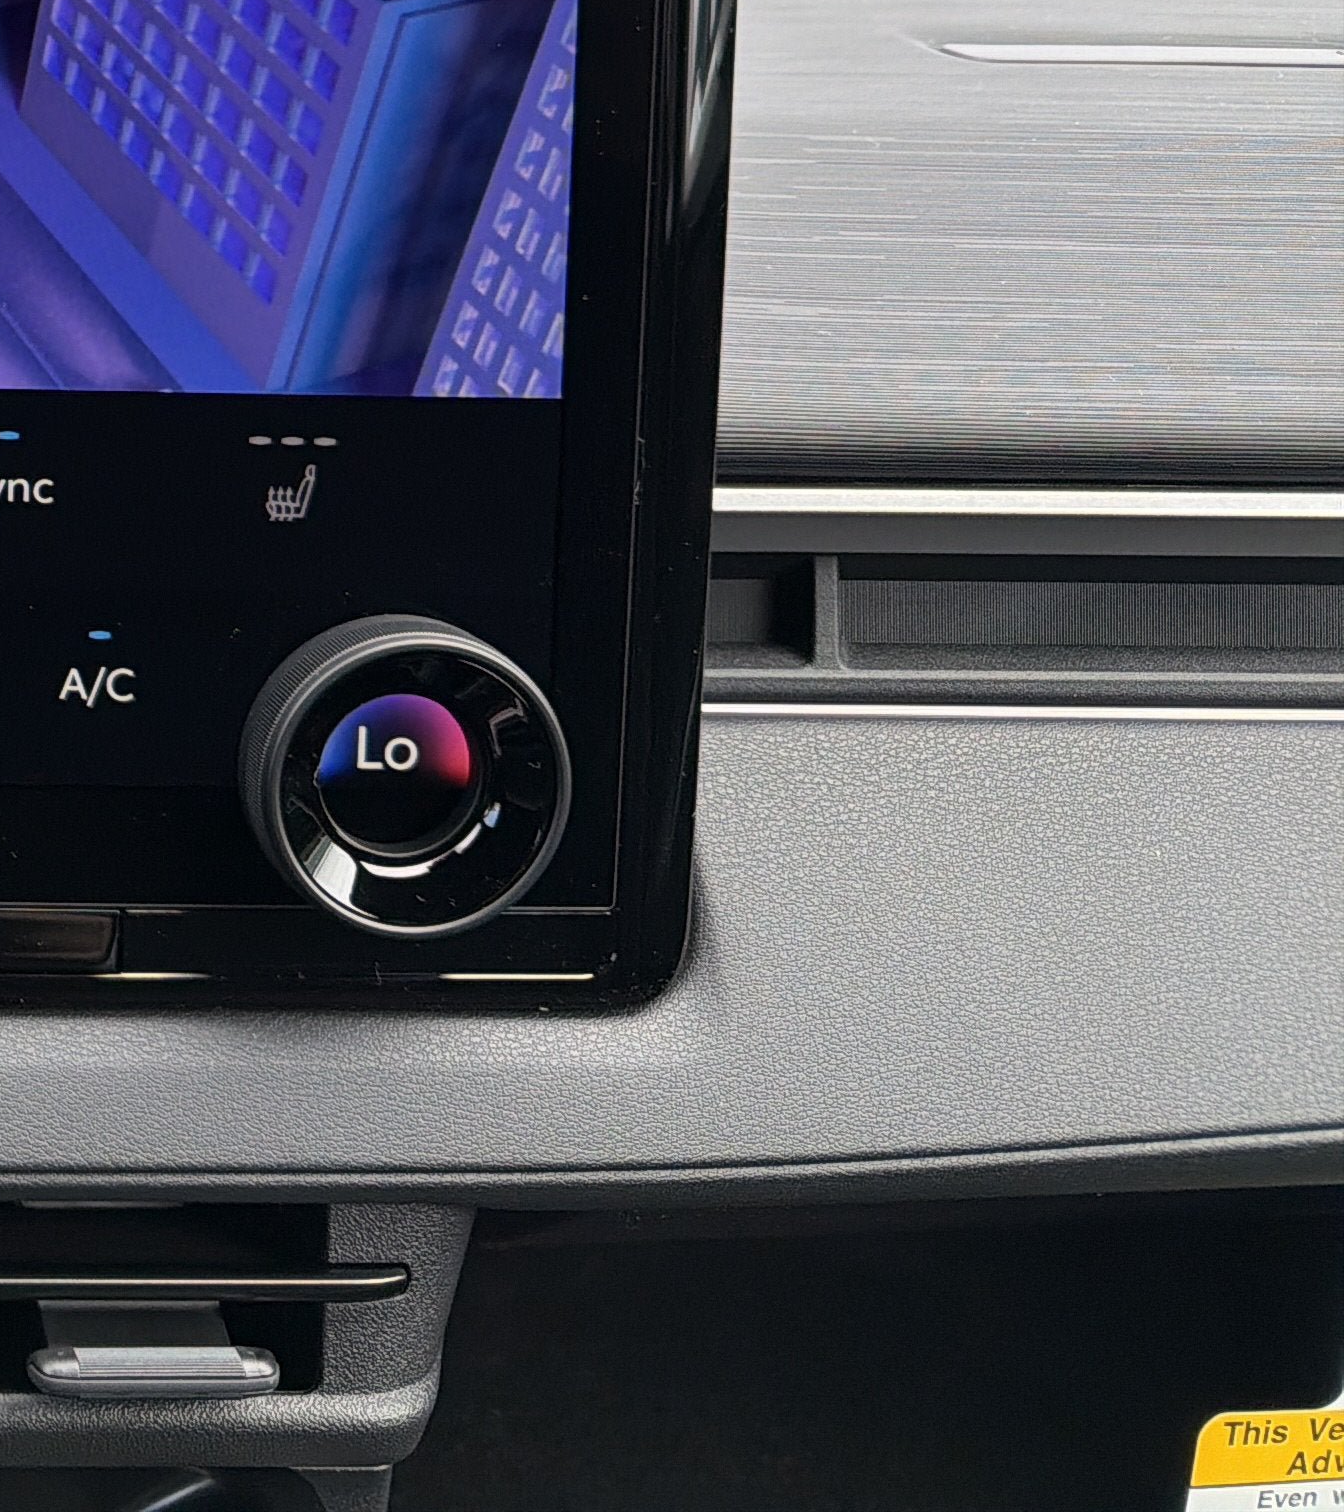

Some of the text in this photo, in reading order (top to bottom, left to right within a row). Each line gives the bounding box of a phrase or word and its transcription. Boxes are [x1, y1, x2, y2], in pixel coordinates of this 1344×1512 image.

[59, 666, 136, 708] A/C
[355, 728, 418, 773] Lo
[1223, 1419, 1289, 1446] This
[1257, 1490, 1318, 1509] Even
